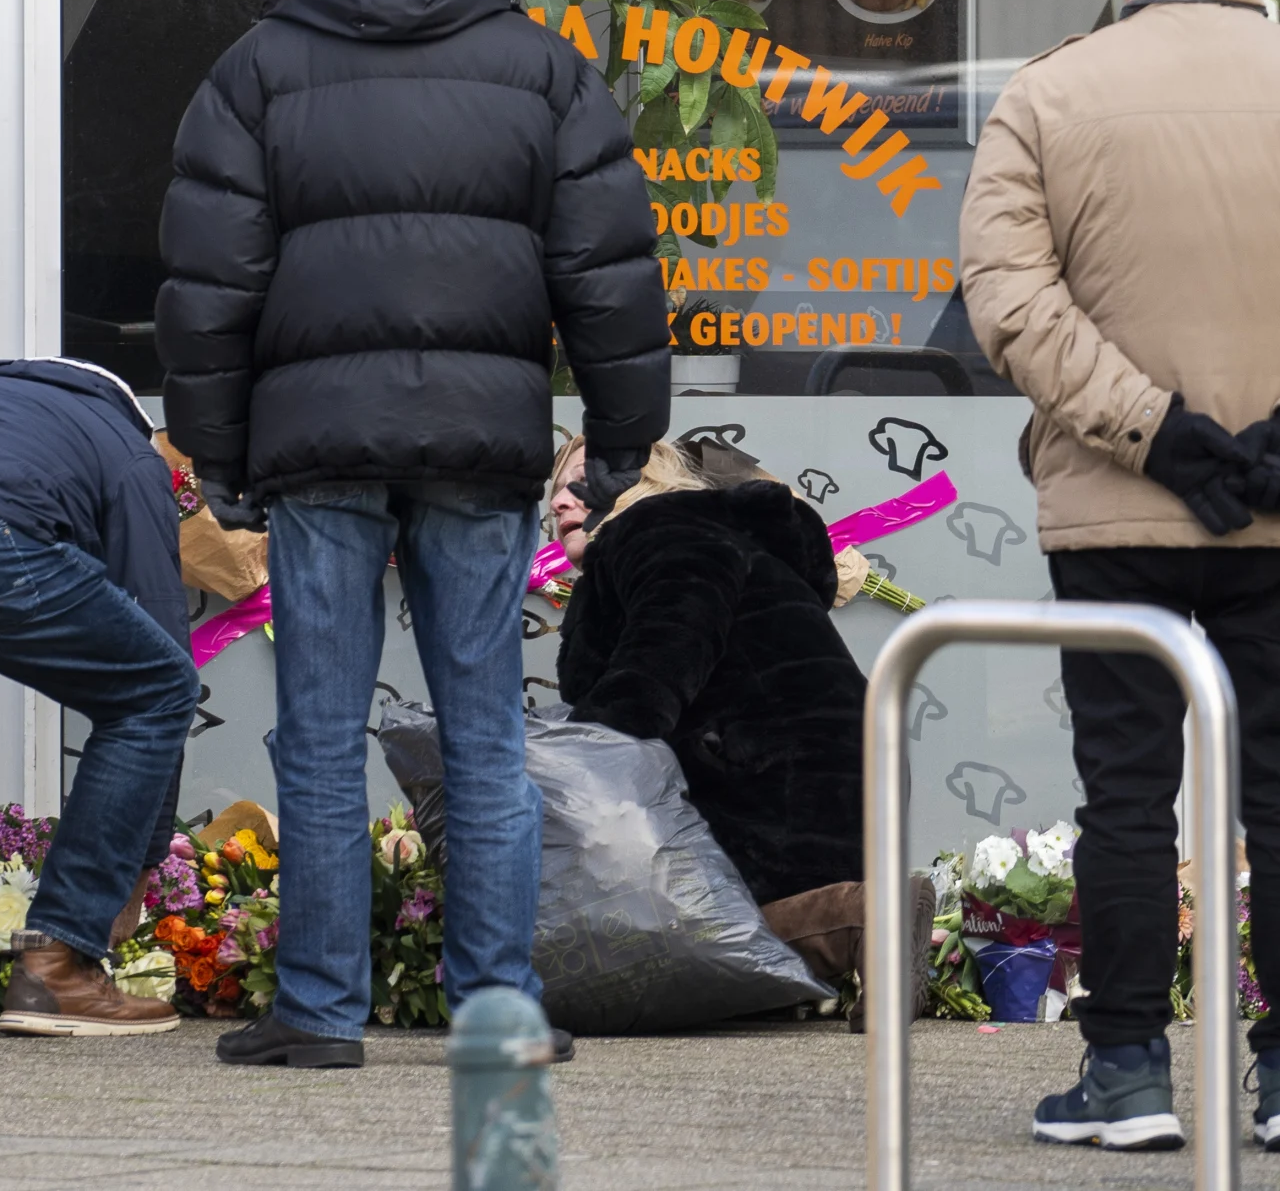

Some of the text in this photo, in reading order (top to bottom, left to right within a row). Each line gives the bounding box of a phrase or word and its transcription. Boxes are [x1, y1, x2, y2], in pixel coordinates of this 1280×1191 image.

[864, 33, 914, 50] Halve Kip
[620, 5, 943, 218] HOUTWIJK
[632, 147, 762, 182] NACKS
[807, 256, 955, 303] SOFTIJS
[689, 312, 877, 346] GEOPEND
[889, 312, 903, 346] !
